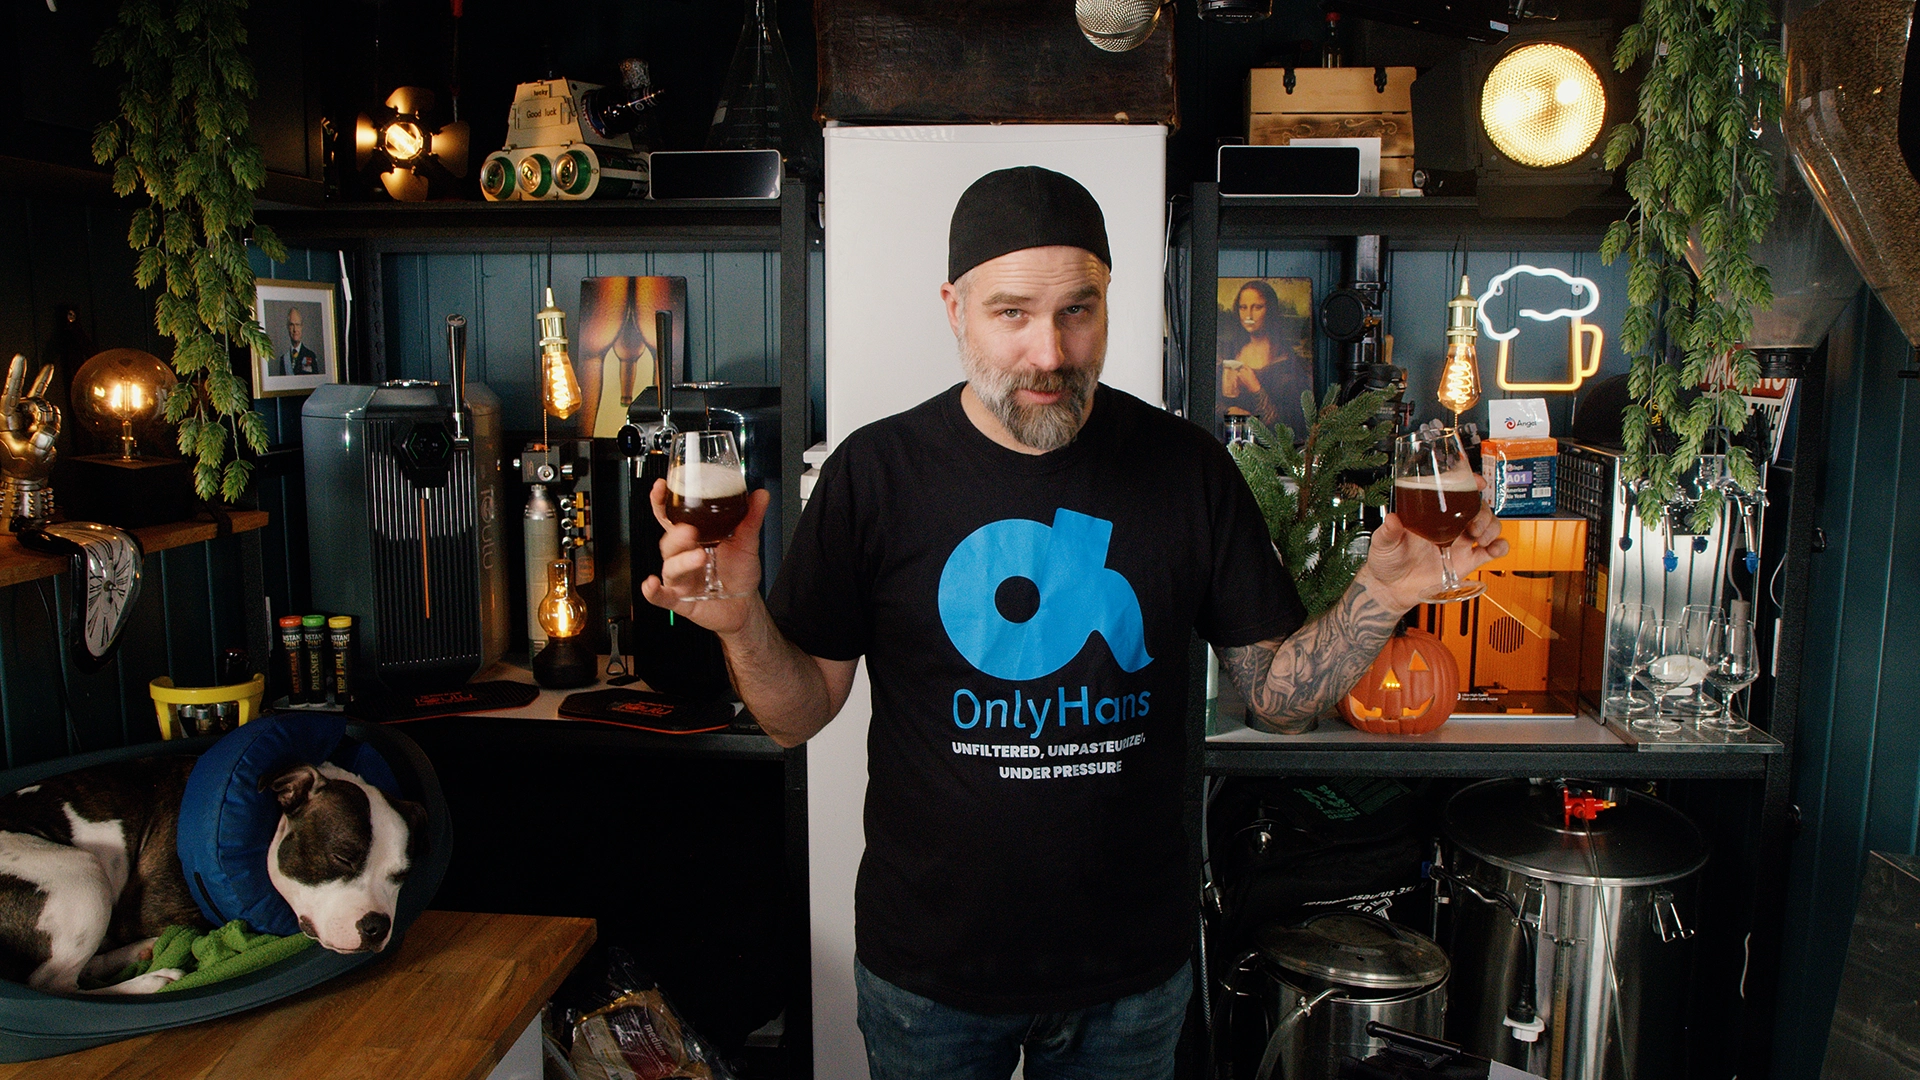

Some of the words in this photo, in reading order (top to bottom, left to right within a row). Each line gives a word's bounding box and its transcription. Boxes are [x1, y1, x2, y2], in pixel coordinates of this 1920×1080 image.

[526, 110, 542, 118] Good
[544, 107, 557, 117] luck
[1516, 419, 1537, 429] Angel
[1507, 473, 1527, 483] A01
[952, 685, 1151, 739] OnlyHans
[951, 741, 1046, 760] UNFILTERED,
[999, 766, 1051, 780] UNDER
[1052, 760, 1122, 778] PRESSURE
[644, 1023, 667, 1057] medium
